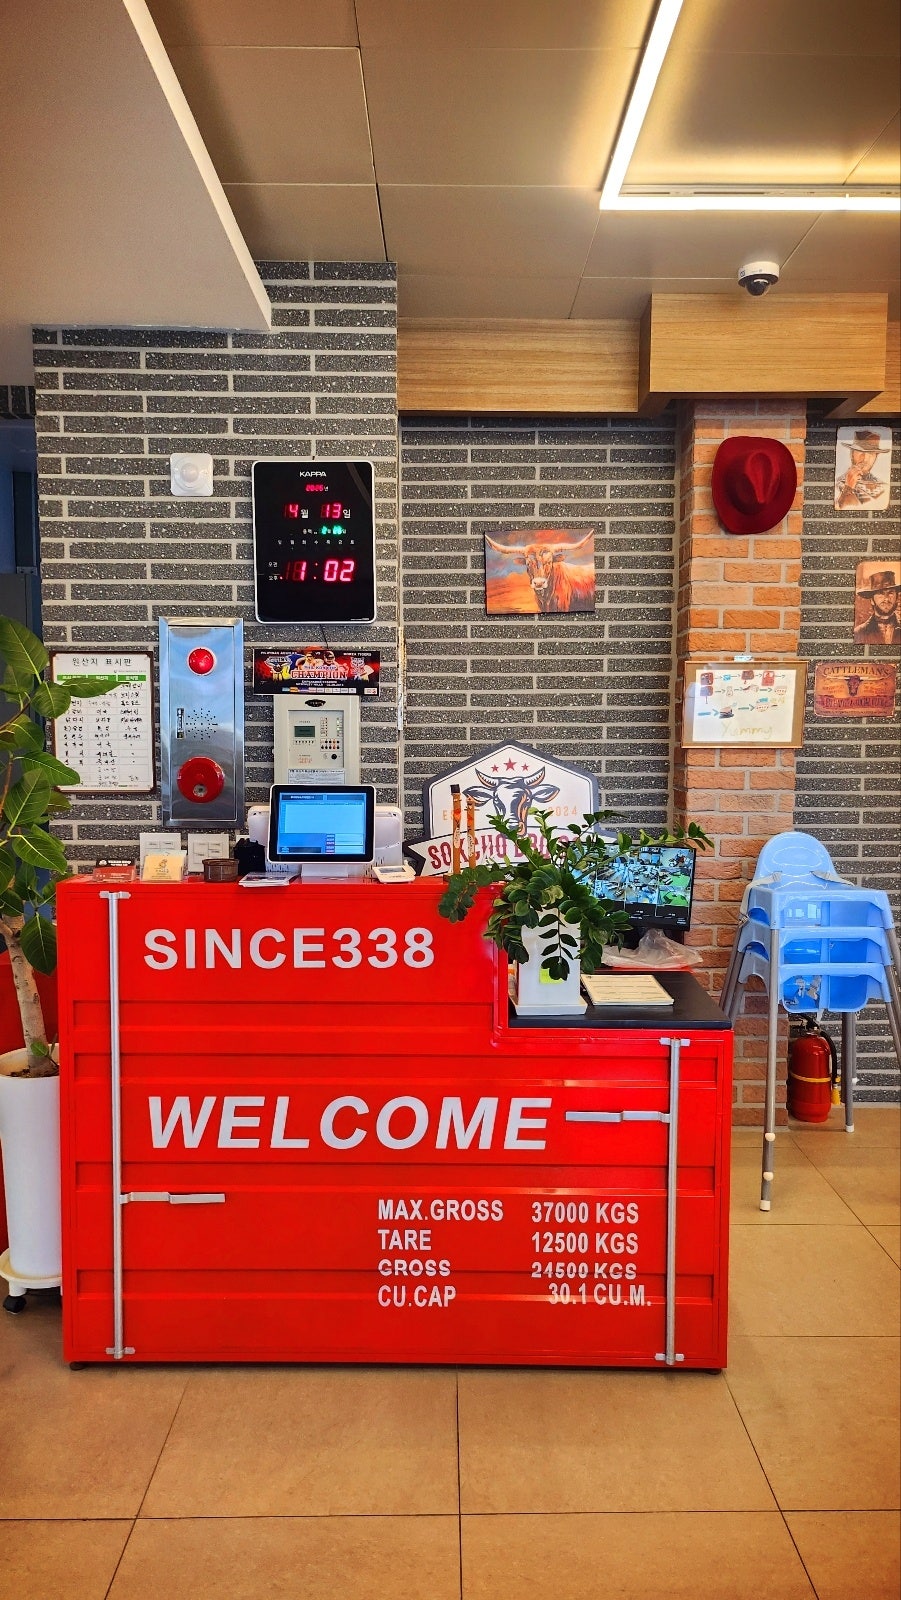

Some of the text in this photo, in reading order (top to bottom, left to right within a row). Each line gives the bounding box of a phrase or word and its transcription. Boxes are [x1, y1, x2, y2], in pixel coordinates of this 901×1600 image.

[72, 658, 132, 666] 원산지 표시판
[291, 670, 347, 679] CHAMPION
[143, 927, 436, 971] SINCE338
[148, 1096, 552, 1150] WELCOME
[378, 1199, 639, 1224] MAX.GROSS 37000 KGS
[378, 1229, 639, 1254] TARE 12500 KGS
[378, 1258, 637, 1280] GROSS 24500 KGS
[378, 1282, 652, 1308] CU.CAP 30.1 CU.M.
